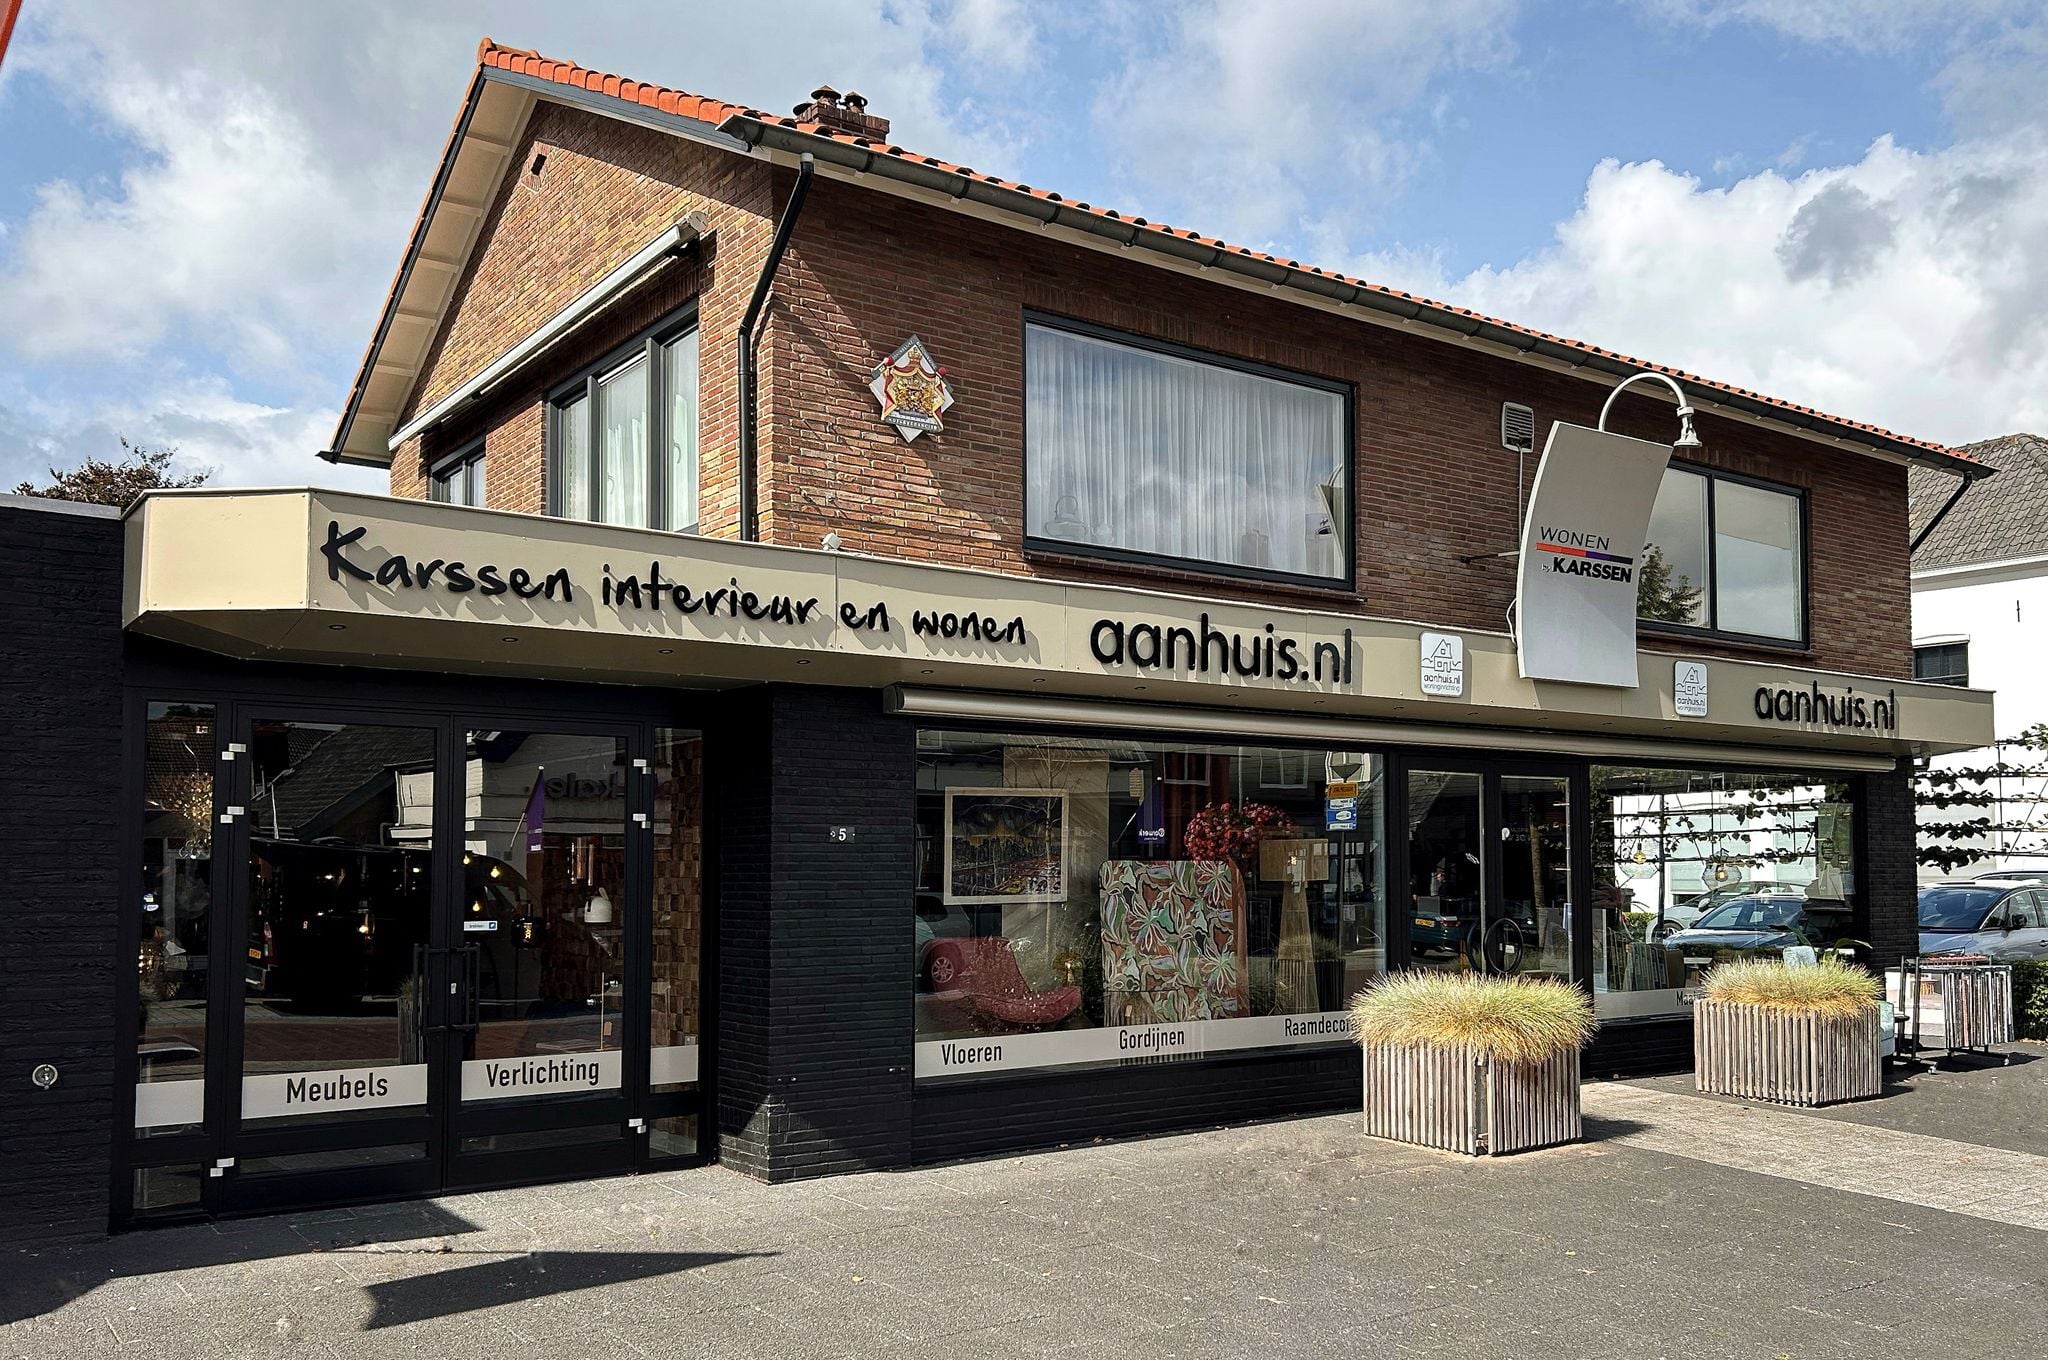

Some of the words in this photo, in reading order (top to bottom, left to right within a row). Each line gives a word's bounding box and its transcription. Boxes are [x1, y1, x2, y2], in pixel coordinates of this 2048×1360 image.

[1540, 526, 1610, 550] WONEN
[321, 521, 572, 602] Karssen
[602, 560, 818, 625] interieur
[840, 602, 889, 632] en
[912, 609, 1027, 645] wonen
[1553, 557, 1633, 583] KARSSEN
[1090, 613, 1353, 684] aanhuis.nl
[1424, 674, 1461, 685] aanhuis.nl
[1755, 680, 1895, 729] aanhuis.nl
[838, 828, 847, 841] 5
[1119, 1027, 1185, 1052] Gordijnen
[941, 1043, 1002, 1066] Vloeren
[485, 1058, 600, 1087] Verlichting
[286, 1074, 389, 1104] Meubels
